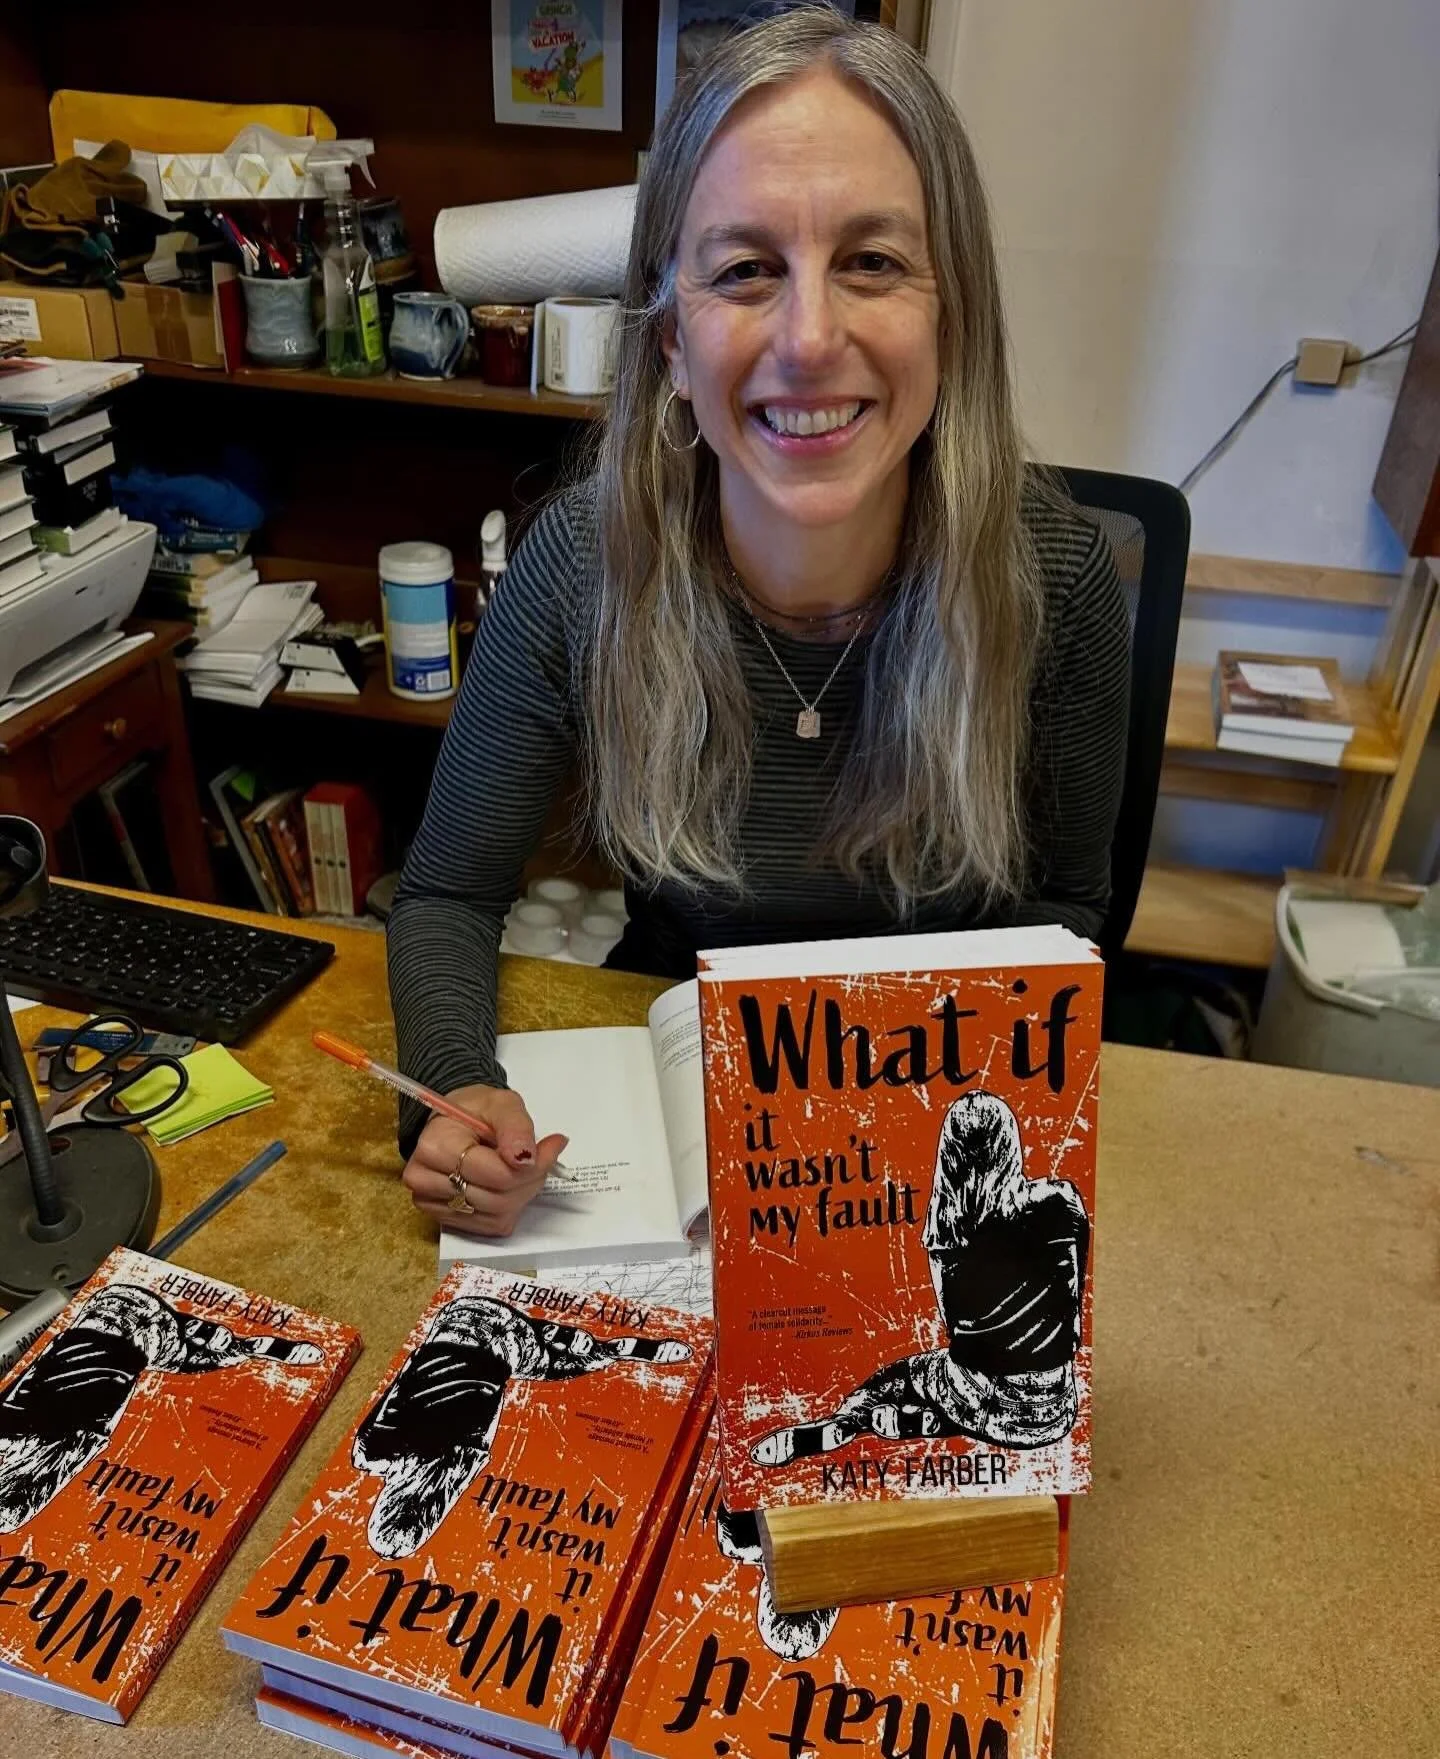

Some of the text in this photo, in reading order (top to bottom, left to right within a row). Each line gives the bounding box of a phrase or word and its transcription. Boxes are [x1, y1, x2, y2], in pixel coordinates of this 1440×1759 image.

[739, 989, 979, 1094] What
[1012, 979, 1081, 1093] if
[744, 1103, 779, 1152] it
[745, 1135, 878, 1191] wasn't
[816, 1182, 922, 1237] fault
[159, 1272, 291, 1331] KATY FARBER
[508, 1281, 651, 1331] KATY FARBER
[759, 1320, 786, 1331] female
[793, 1305, 827, 1316] message
[822, 1325, 854, 1337] Reviews
[84, 1459, 175, 1511] fault
[472, 1474, 566, 1525] fault
[822, 1453, 1008, 1493] KATY FARBER
[88, 1500, 200, 1554] wasn't
[487, 1516, 606, 1567] wasn't
[141, 1553, 182, 1597] it
[255, 1534, 350, 1639] if
[553, 1567, 594, 1614] it
[0, 1556, 143, 1684] Wha
[349, 1568, 564, 1708] What
[895, 1607, 1029, 1661] wasn't
[664, 1634, 750, 1756] if
[986, 1663, 1024, 1718] it
